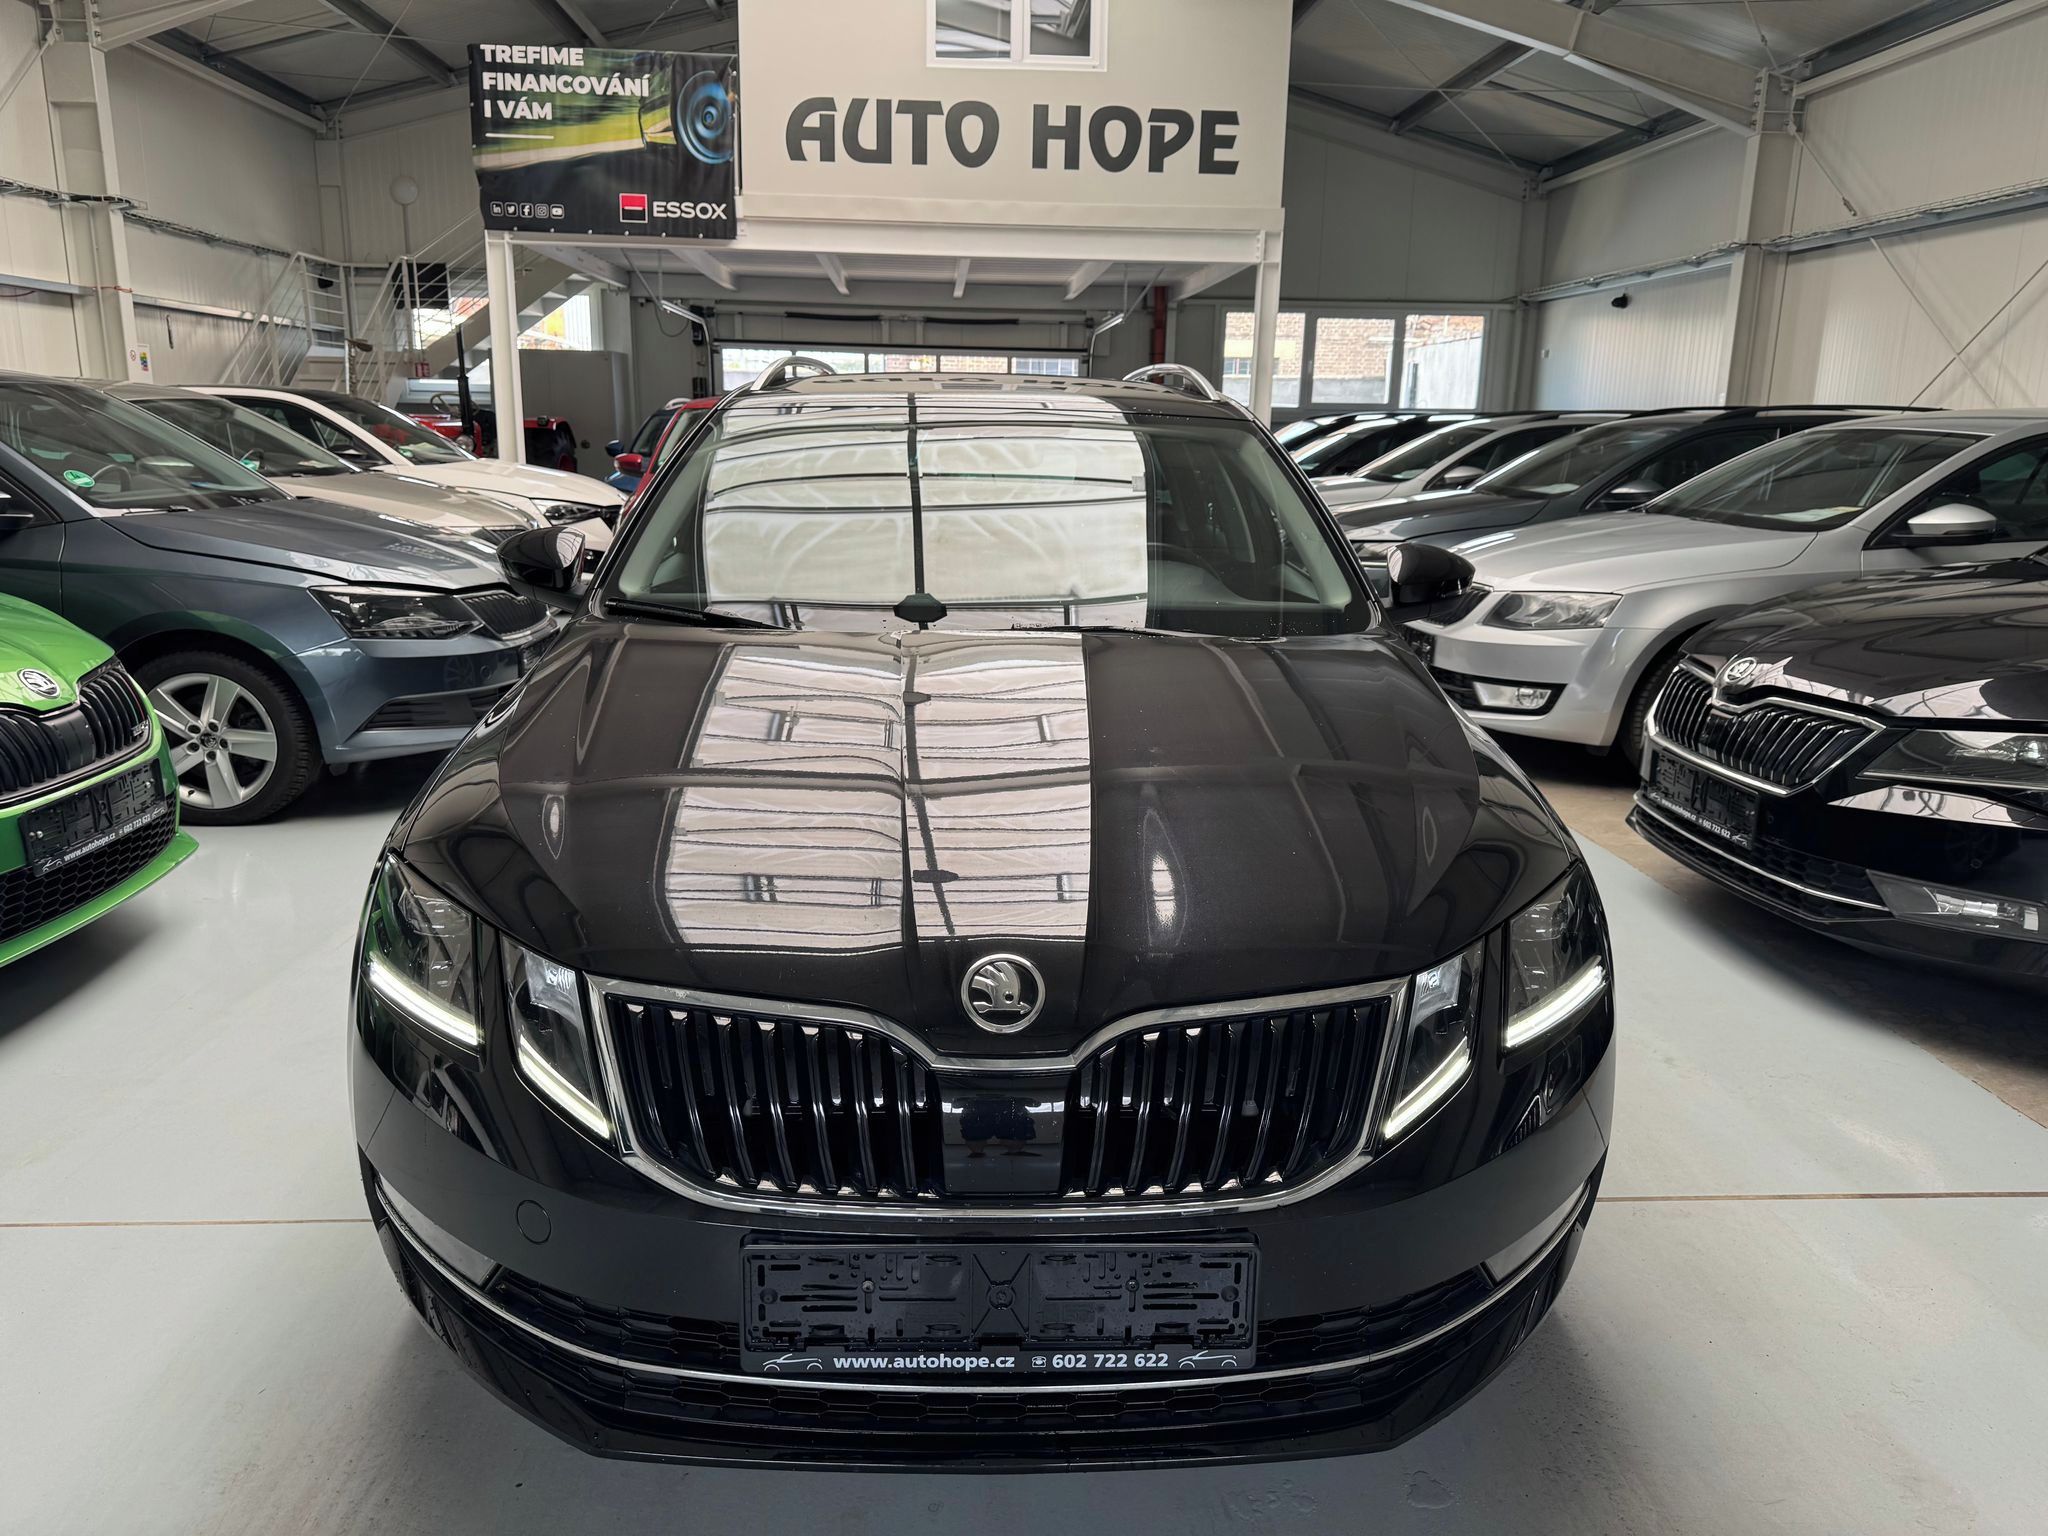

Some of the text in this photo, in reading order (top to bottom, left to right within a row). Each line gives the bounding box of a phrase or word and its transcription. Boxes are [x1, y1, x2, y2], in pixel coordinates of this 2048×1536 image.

[482, 72, 649, 97] FINANCOVÁNÍ
[483, 97, 552, 120] I VÁM
[785, 96, 1240, 175] AUTO HOPE
[652, 200, 727, 220] ESSOX
[63, 832, 116, 861] www.autohope.cz
[833, 1353, 1169, 1371] www.autohope.cz 602 722 622
